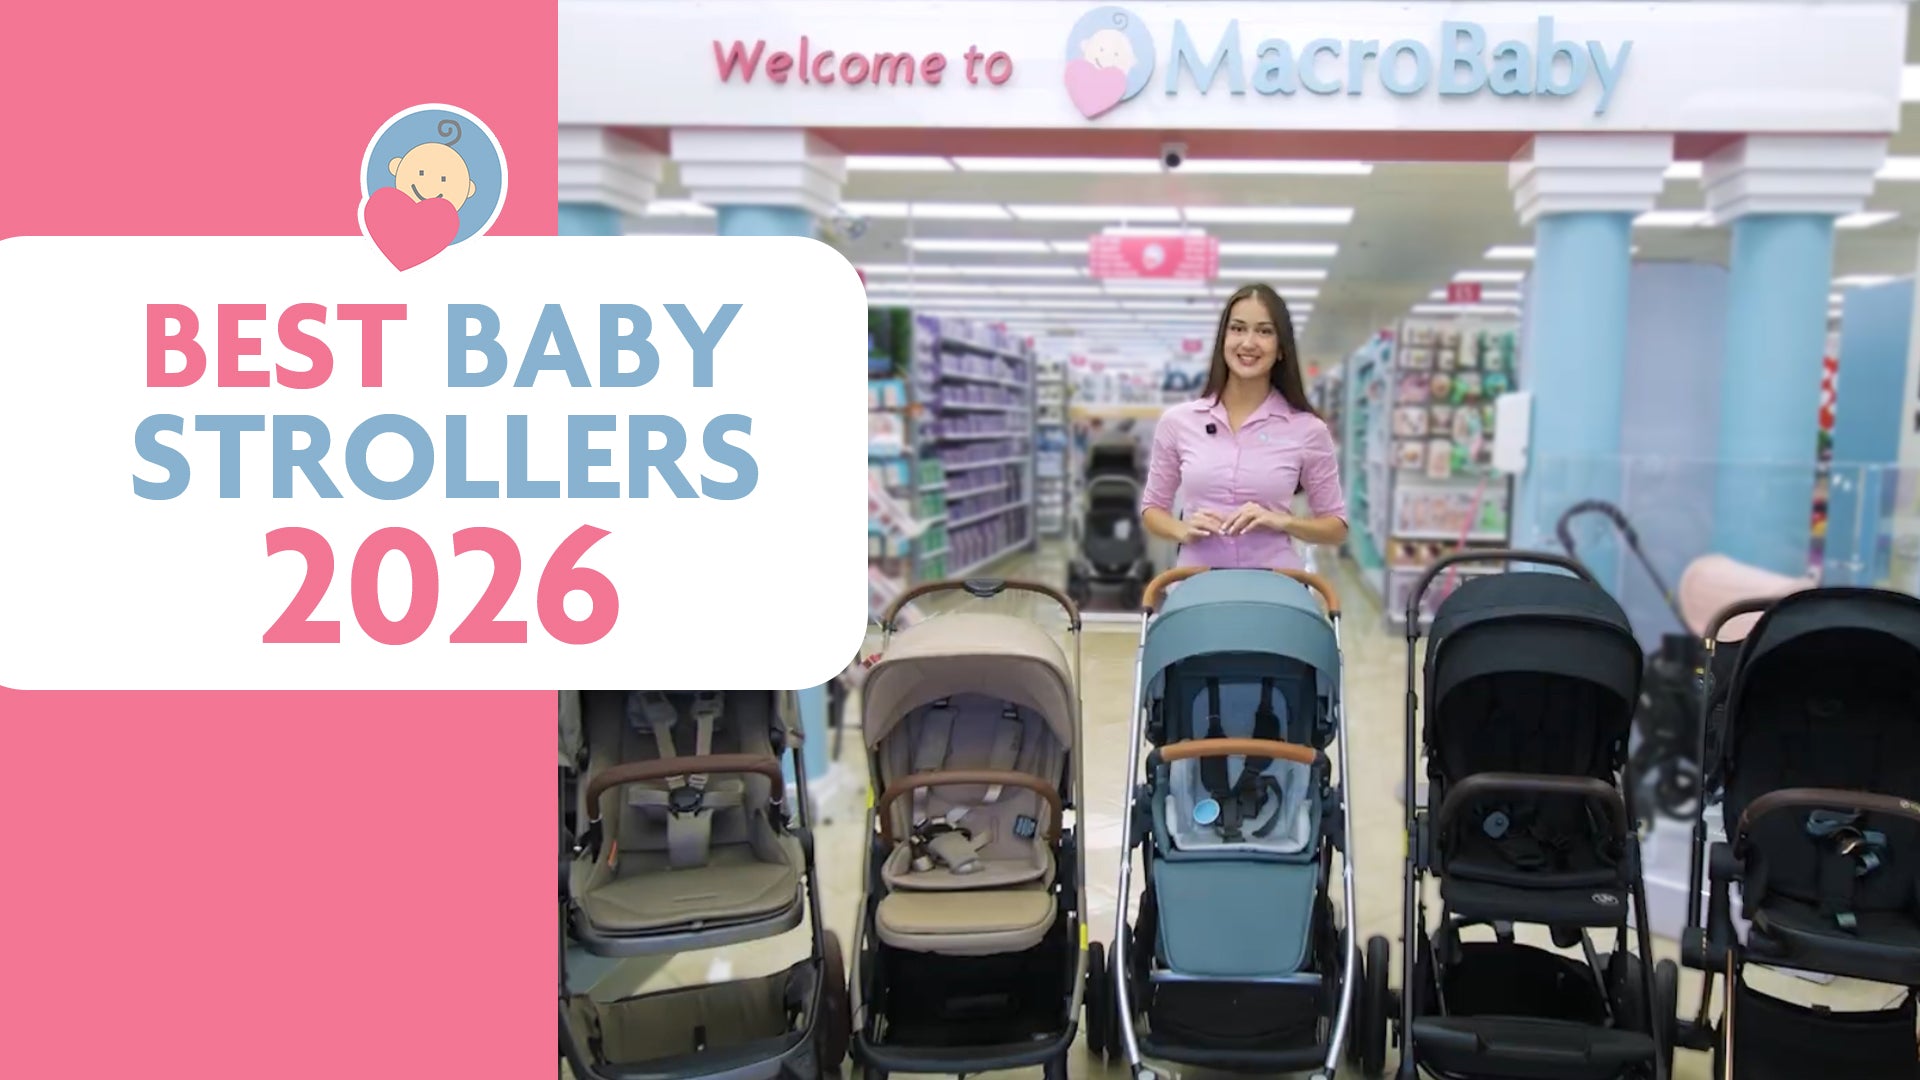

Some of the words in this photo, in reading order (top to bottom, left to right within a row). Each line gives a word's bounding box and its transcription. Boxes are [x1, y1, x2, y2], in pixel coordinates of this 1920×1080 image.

[713, 35, 946, 86] Welcome
[963, 45, 1014, 86] to
[1164, 16, 1634, 115] MacroBaby
